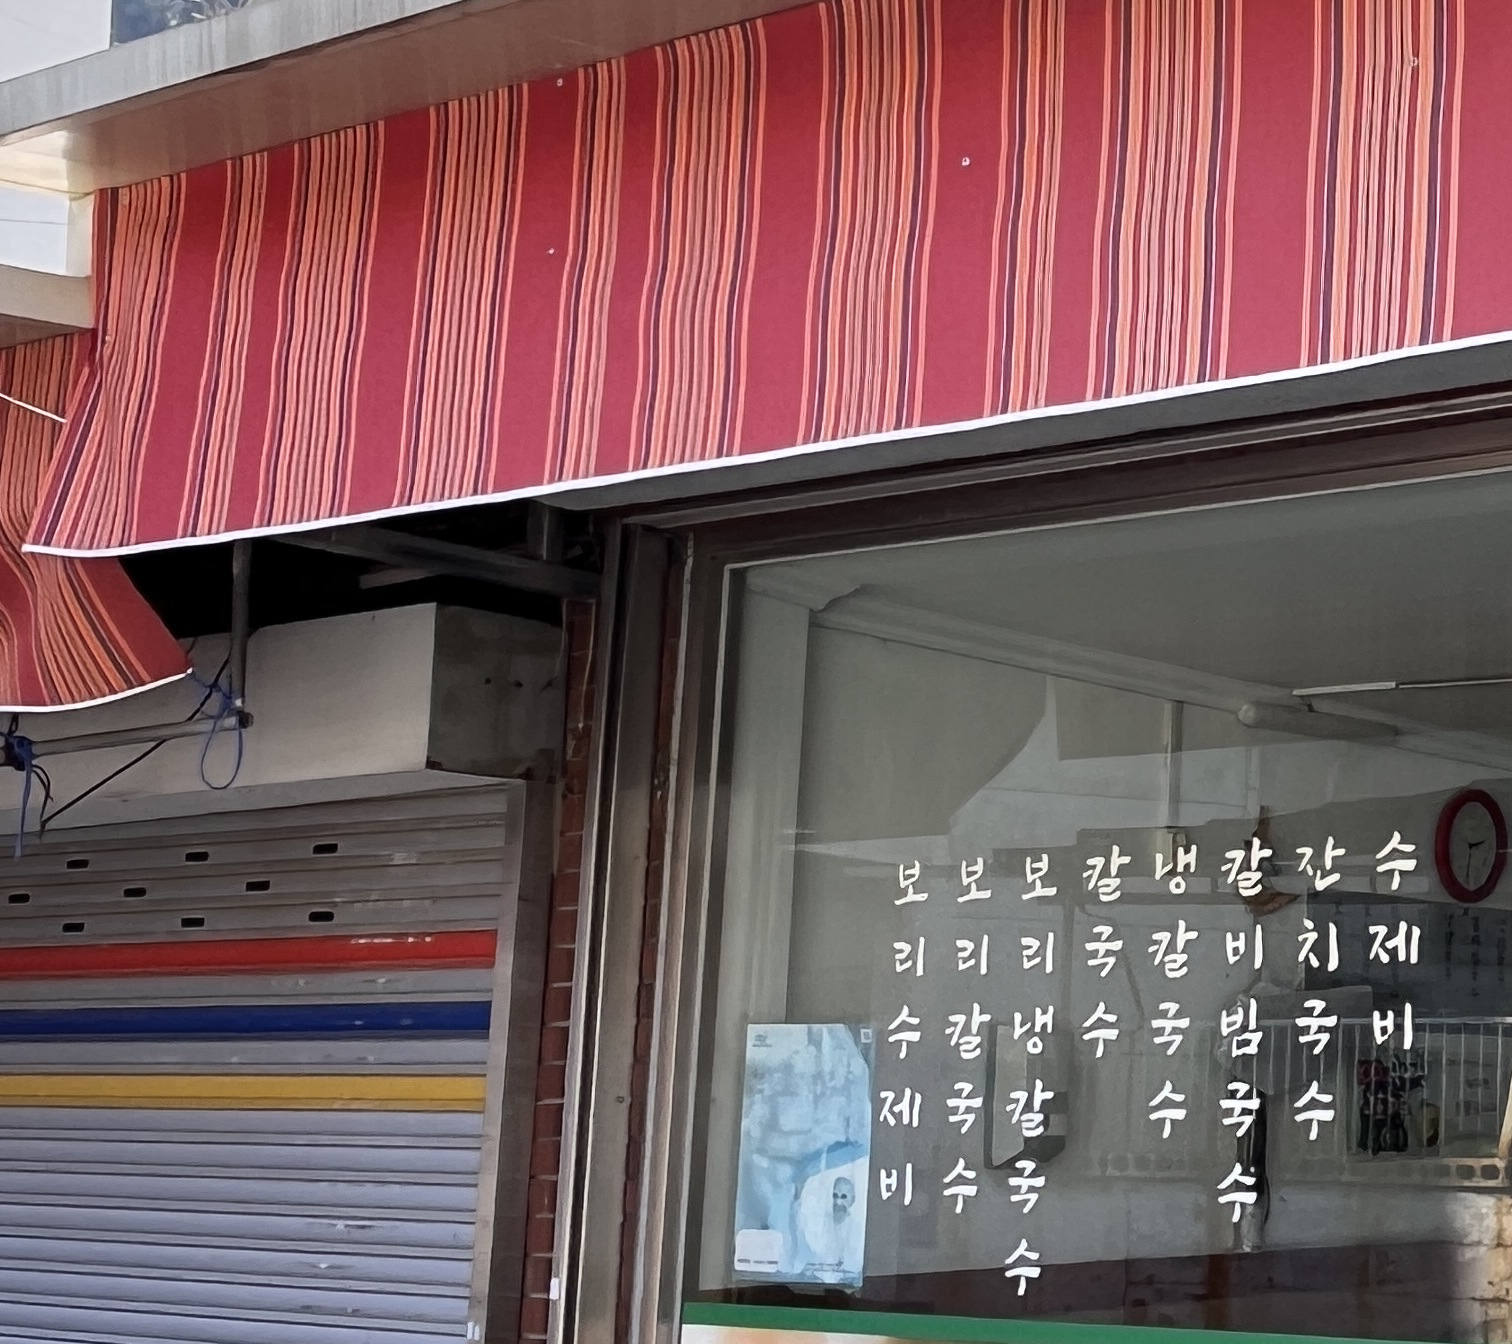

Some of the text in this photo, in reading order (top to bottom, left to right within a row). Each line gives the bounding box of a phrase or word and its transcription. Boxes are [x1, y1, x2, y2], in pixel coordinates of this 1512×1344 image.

[879, 861, 928, 1206] 보리수제비
[943, 858, 992, 1213] 보리칼국수
[1004, 854, 1057, 1296] 보리냉칼국수
[1080, 845, 1132, 1058] 칼국수
[1147, 845, 1199, 1139] 냉칼국수
[1217, 838, 1273, 1223] 칼비빔국수
[1293, 837, 1346, 1141] 잔치국수
[1368, 831, 1421, 1050] 수제비
